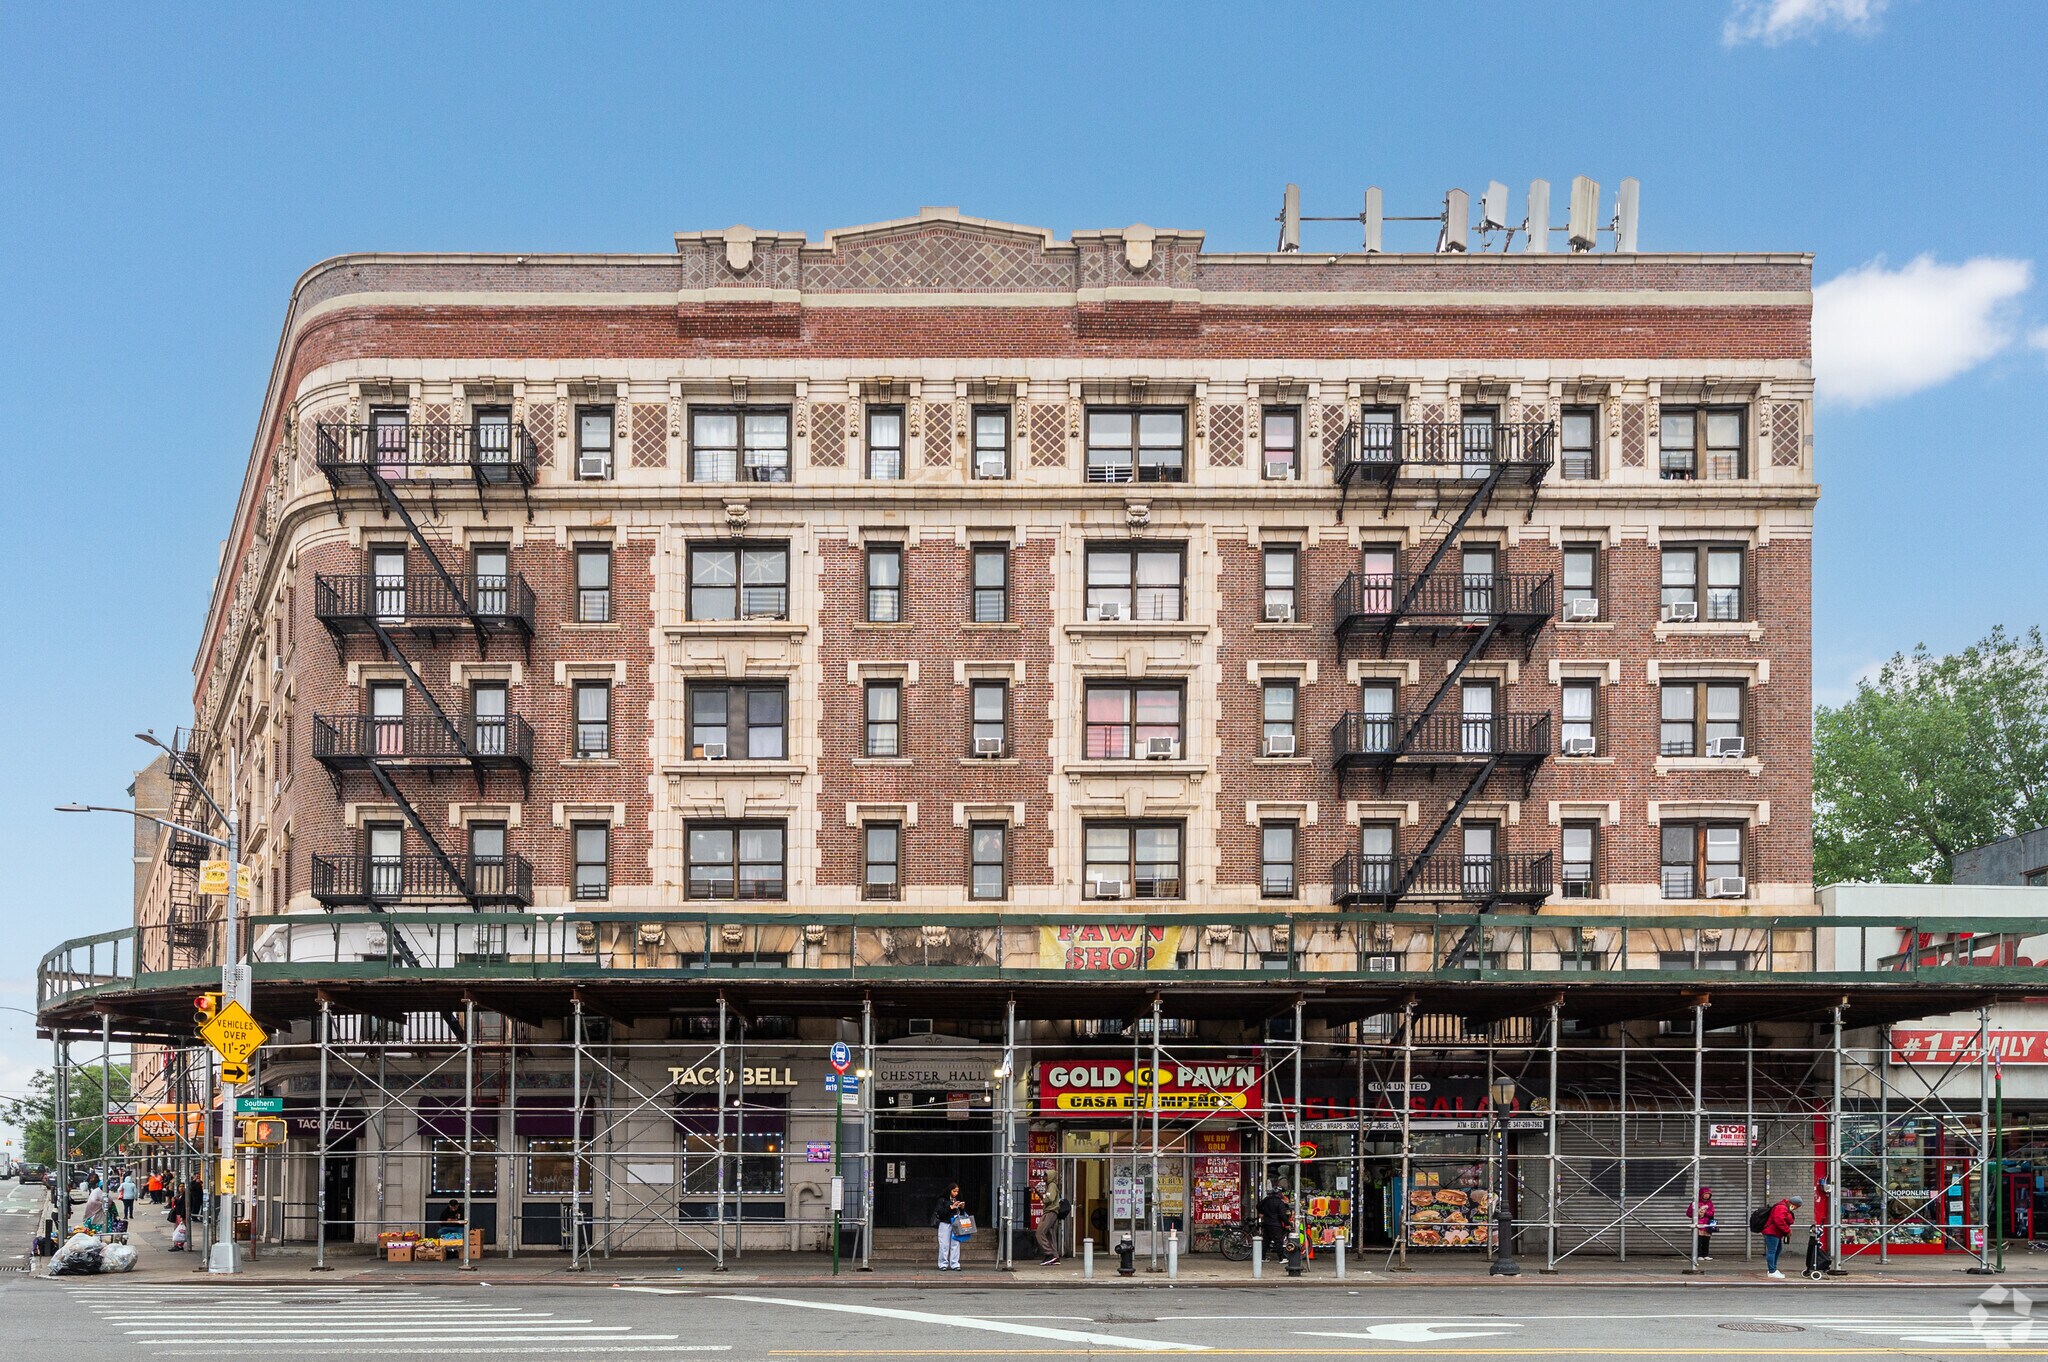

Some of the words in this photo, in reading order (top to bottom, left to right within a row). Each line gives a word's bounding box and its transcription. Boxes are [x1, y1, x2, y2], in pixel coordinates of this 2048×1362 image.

[1058, 924, 1164, 942] PAWN
[1065, 946, 1155, 970] SHOP
[217, 1019, 254, 1031] VEHICLES
[223, 1030, 247, 1040] OVER
[223, 1042, 251, 1056] 11'-2"
[1902, 1032, 1943, 1061] #1
[1949, 1036, 2036, 1057] FAMILY
[667, 1067, 735, 1086] TACO
[742, 1067, 798, 1086] BELL
[880, 1070, 940, 1081] CHESTER
[949, 1070, 986, 1081] HALL
[1049, 1066, 1121, 1088] GOLD
[1177, 1066, 1255, 1088] PAWN
[1372, 1083, 1391, 1091] 104
[1394, 1083, 1427, 1091] UNTED
[244, 1099, 275, 1108] Southern
[1070, 1095, 1114, 1108] CASA
[1123, 1096, 1145, 1107] DE
[1281, 1097, 1357, 1119] DELI
[327, 1120, 352, 1130] BELL
[1293, 1122, 1323, 1130] NDWICHES
[1327, 1122, 1343, 1130] WRAPS
[1208, 1143, 1226, 1151] GOLD
[1207, 1158, 1227, 1166] CASH
[1205, 1166, 1228, 1174] LOANS
